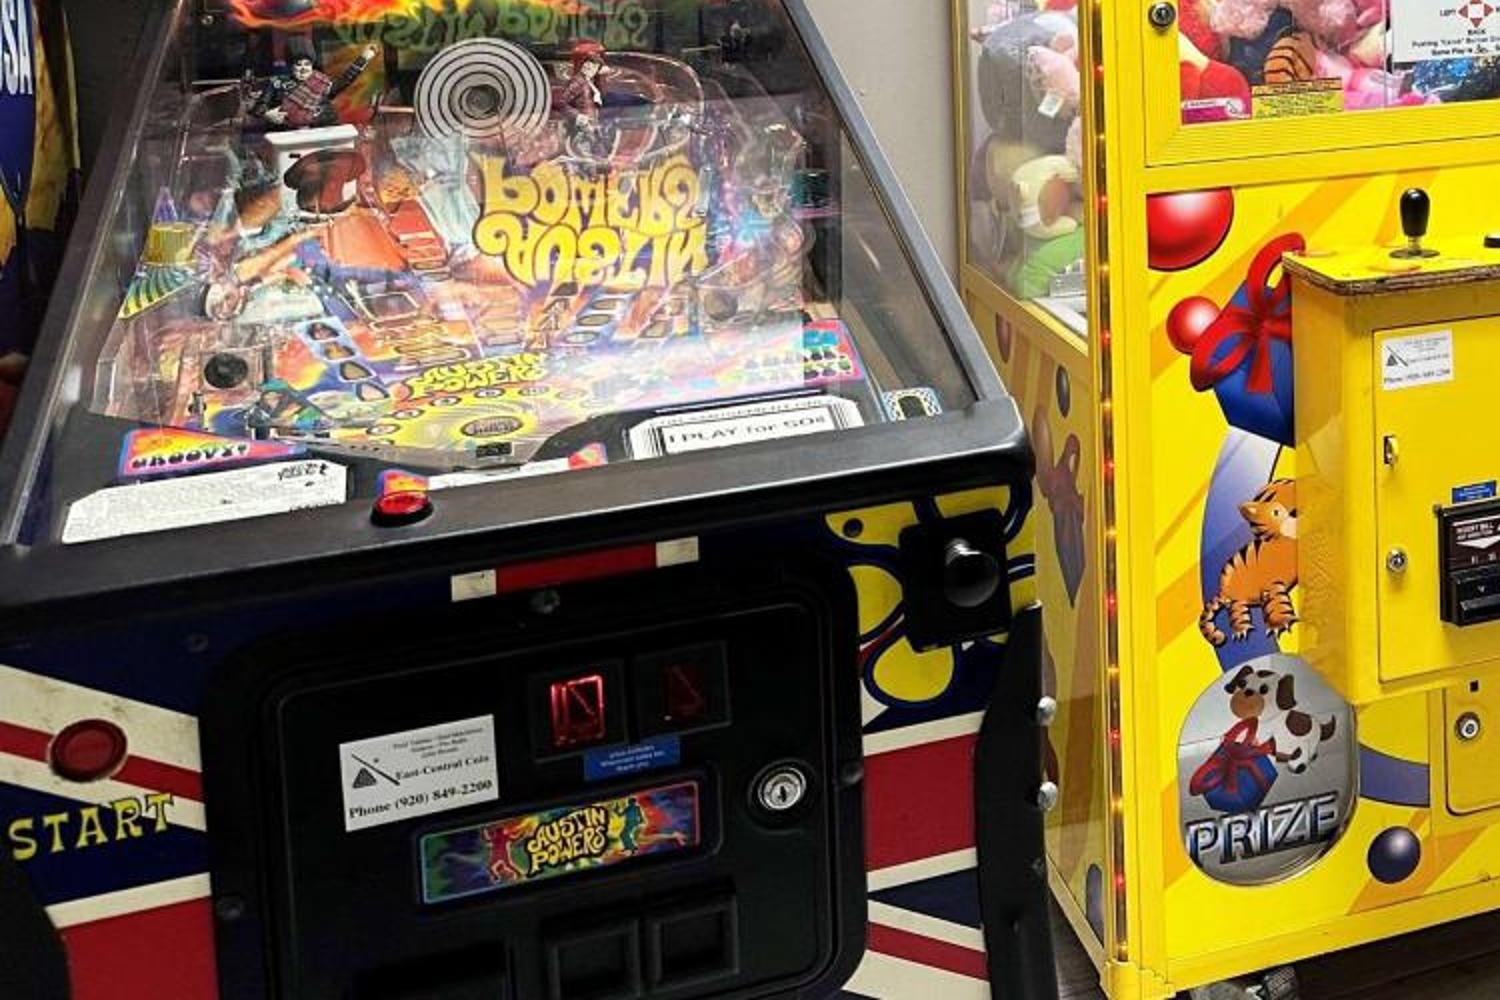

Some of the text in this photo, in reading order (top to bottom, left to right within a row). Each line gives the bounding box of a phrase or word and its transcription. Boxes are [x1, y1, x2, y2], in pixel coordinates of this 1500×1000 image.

[680, 425, 739, 443] PLAY
[746, 421, 778, 437] for
[395, 759, 463, 780] East-Central
[349, 779, 493, 819] Phone (920) 849-2200
[8, 792, 175, 861] START
[526, 806, 608, 853] AUSTIN
[1185, 790, 1341, 866] PRIZE
[527, 825, 609, 877] POWERS
